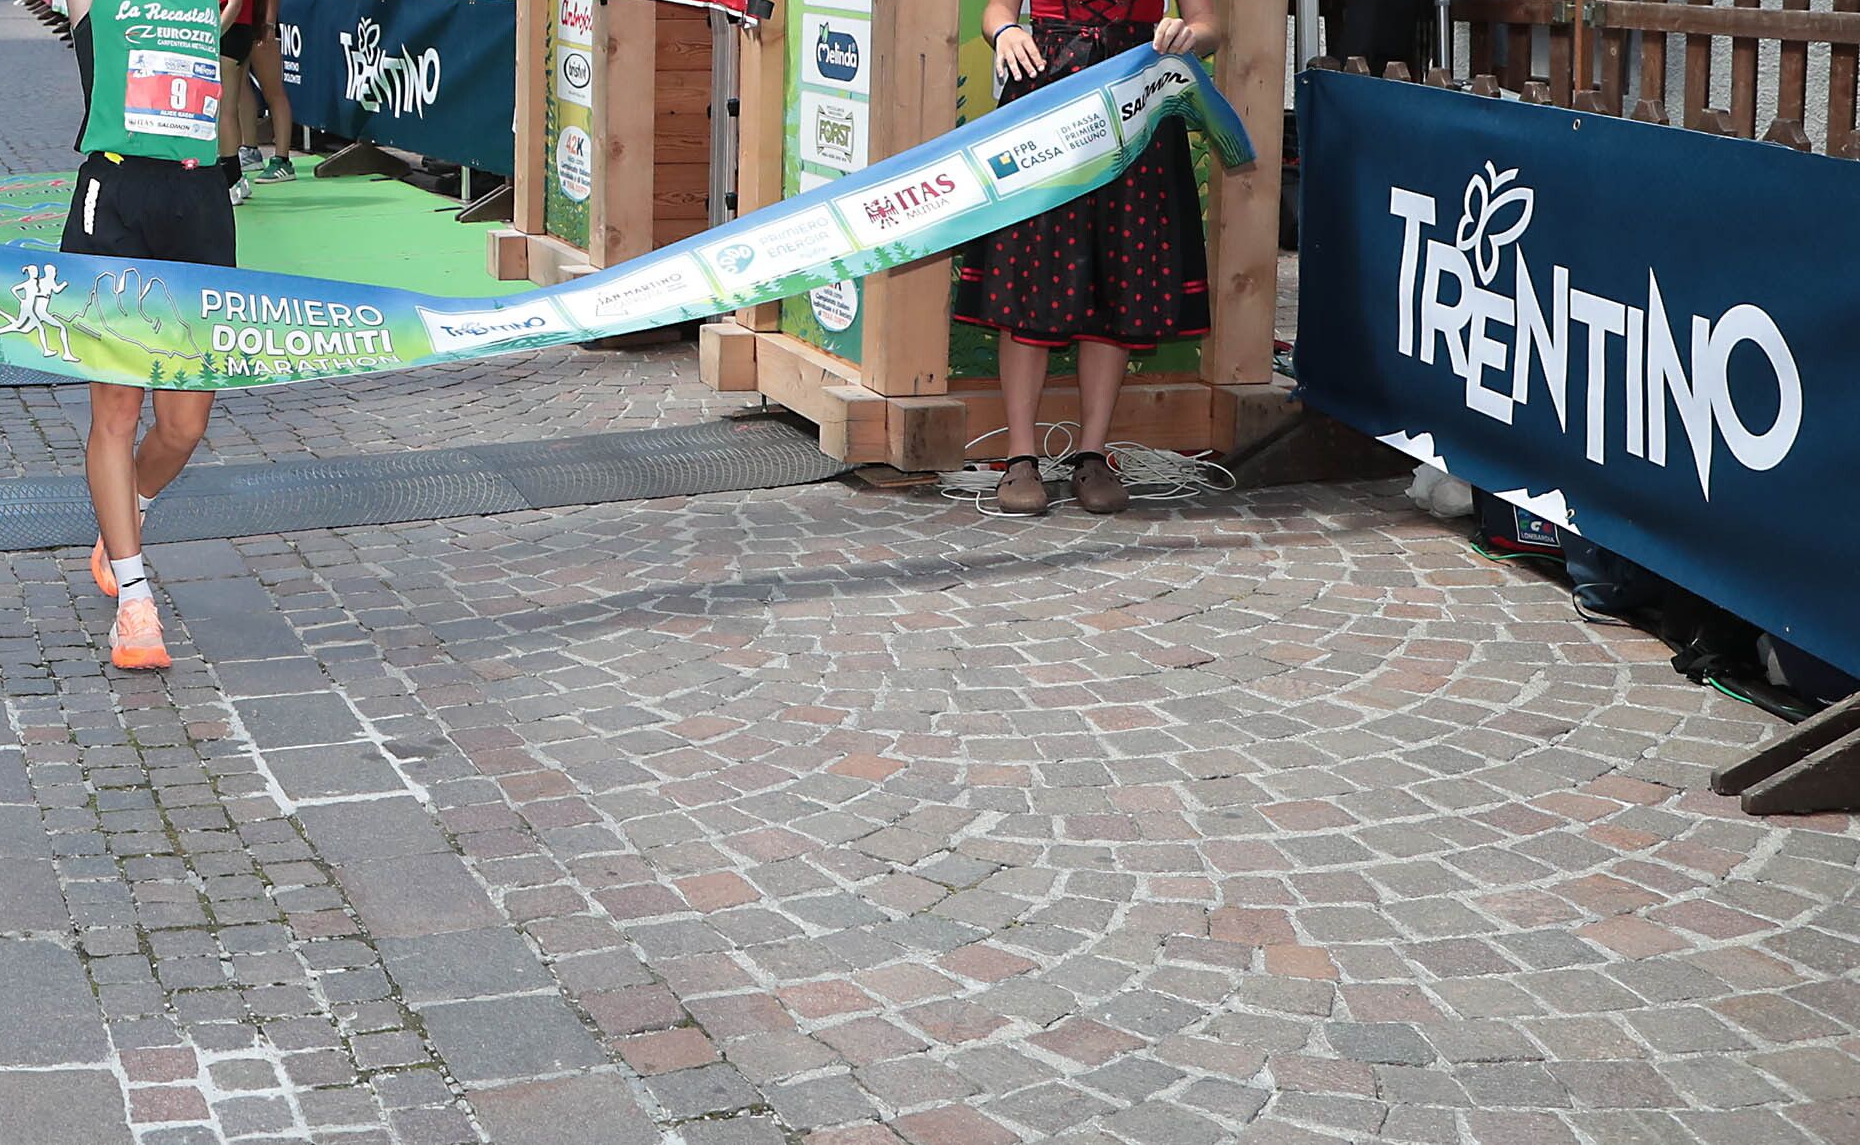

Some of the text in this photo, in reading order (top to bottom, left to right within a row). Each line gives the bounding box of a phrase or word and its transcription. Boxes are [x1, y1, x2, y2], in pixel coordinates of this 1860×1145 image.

[818, 41, 857, 68] Melinda
[340, 32, 440, 119] TRENTINO
[170, 78, 187, 110] 9
[1013, 140, 1037, 157] FPB
[1073, 112, 1100, 129] FASSA
[1065, 119, 1106, 141] PRIMIERO
[1070, 129, 1107, 150] BELLUNO
[1020, 146, 1064, 169] CASSA
[897, 174, 956, 215] ITAS
[905, 197, 951, 222] MUTUA
[200, 288, 384, 327] PRIMIERO
[212, 324, 393, 357] DOLOMITI
[1390, 186, 1803, 503] TRENTINO
[226, 352, 402, 379] MARATHON
